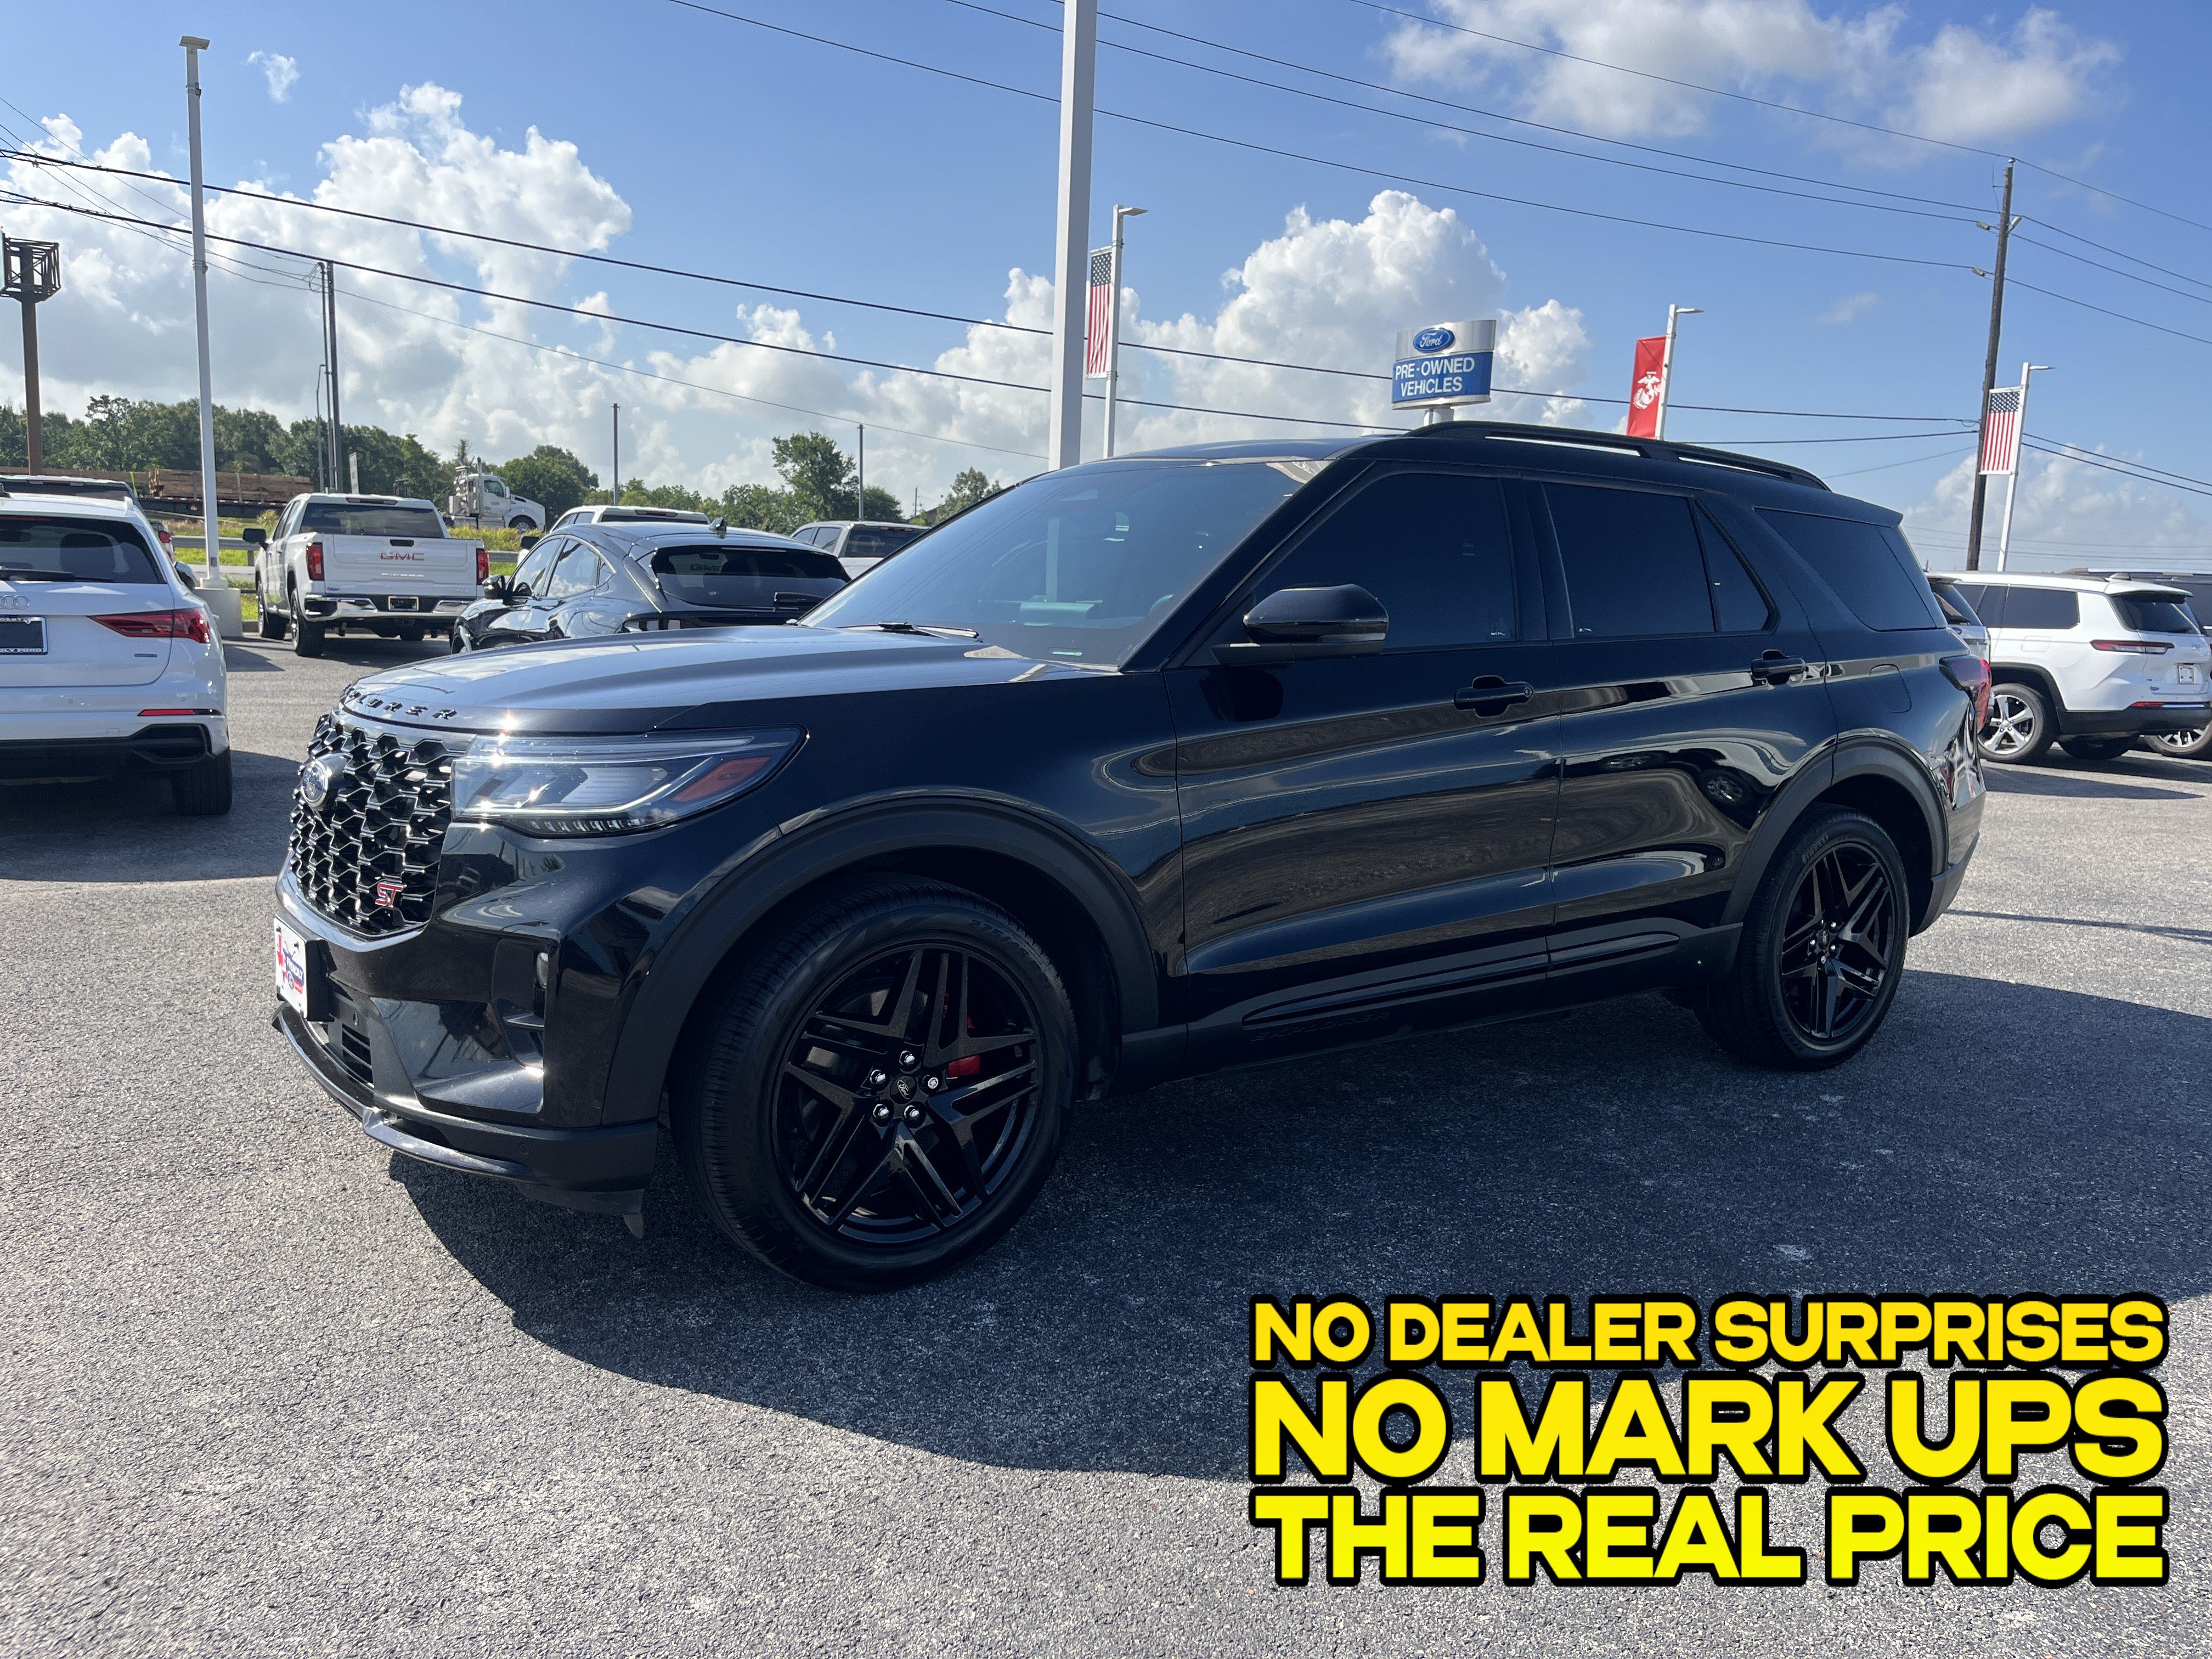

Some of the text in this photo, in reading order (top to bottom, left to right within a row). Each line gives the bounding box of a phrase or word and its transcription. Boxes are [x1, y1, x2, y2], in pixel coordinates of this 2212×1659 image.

[1419, 332, 1443, 348] Ford
[1395, 357, 1475, 380] PRE-OWNED
[1401, 376, 1463, 397] VEHICLES
[380, 552, 425, 561] GMC
[375, 882, 404, 908] ST
